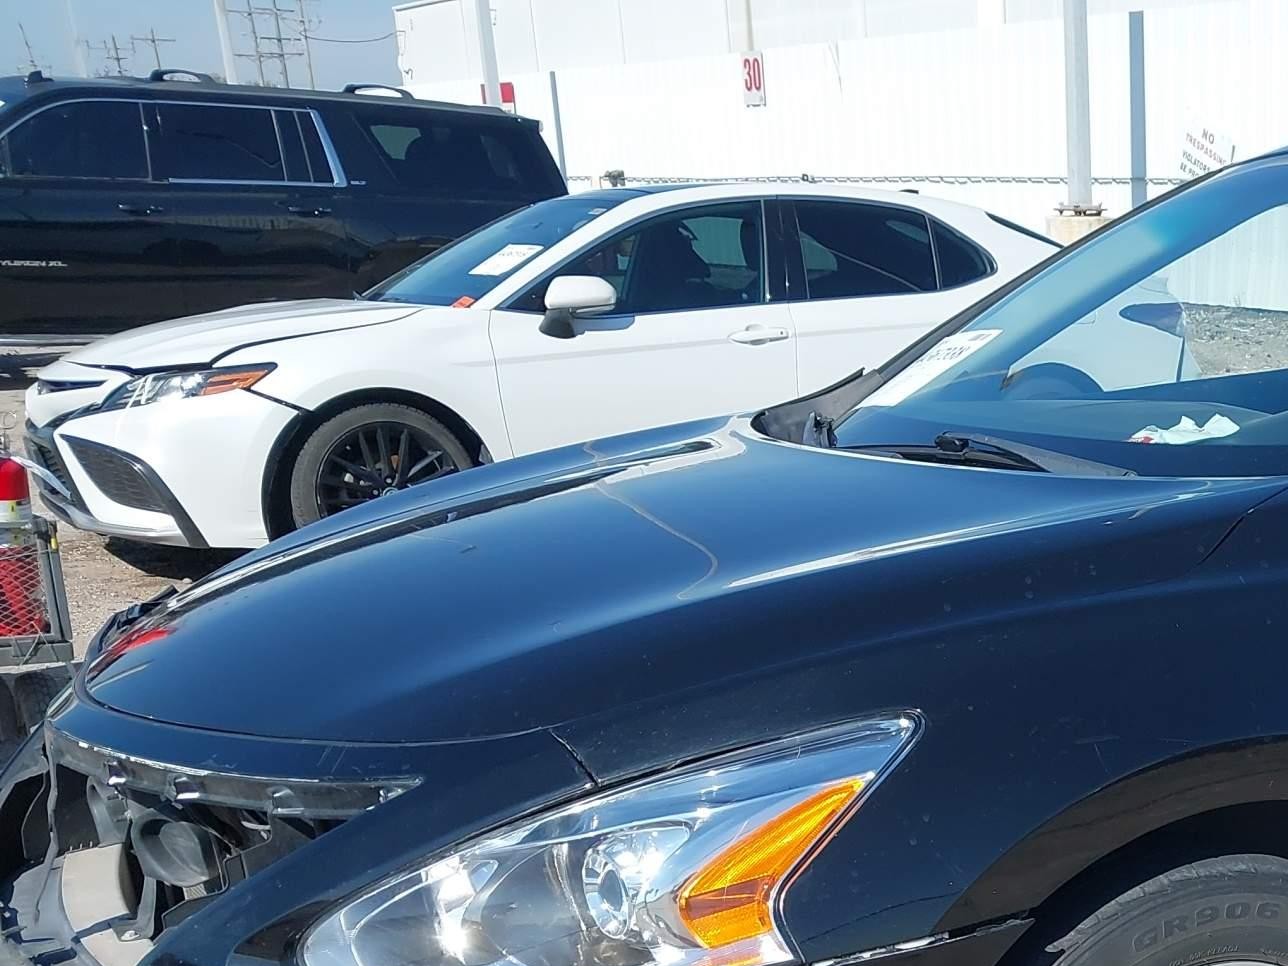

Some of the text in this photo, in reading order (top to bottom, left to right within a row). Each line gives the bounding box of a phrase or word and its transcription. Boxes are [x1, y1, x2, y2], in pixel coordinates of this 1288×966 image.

[744, 57, 761, 91] 30
[1201, 128, 1215, 144] NO
[1132, 902, 1281, 951] GR906
